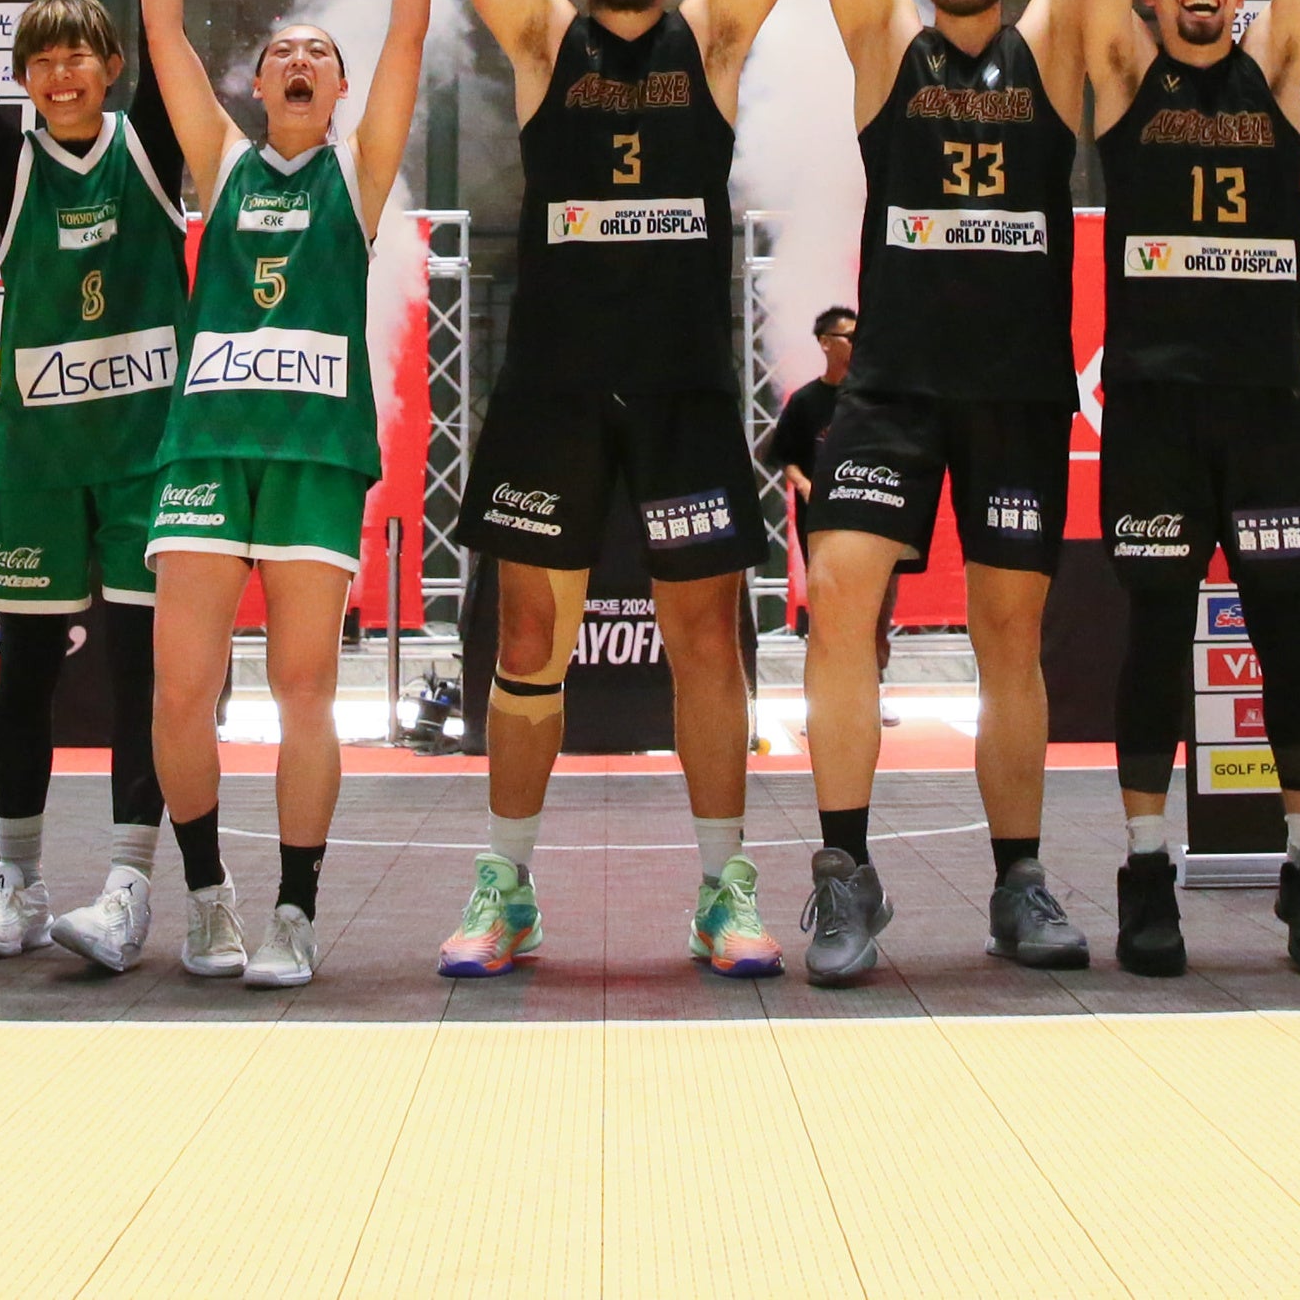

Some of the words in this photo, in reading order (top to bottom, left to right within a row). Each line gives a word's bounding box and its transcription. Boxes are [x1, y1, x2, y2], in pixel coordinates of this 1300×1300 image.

[612, 131, 641, 185] 3
[943, 141, 1005, 197] 33
[615, 210, 646, 218] DISPLAY
[1190, 165, 1247, 222] 13
[960, 220, 992, 228] DISPLAY
[81, 269, 105, 321] 8
[253, 256, 290, 309] 5
[27, 346, 175, 399] ASCENT
[188, 339, 343, 389] ASCENT
[492, 482, 561, 516] Coca-Cola
[1115, 514, 1184, 538] Coca-Cola
[621, 599, 656, 616] 2024
[1214, 763, 1256, 776] GOLF
